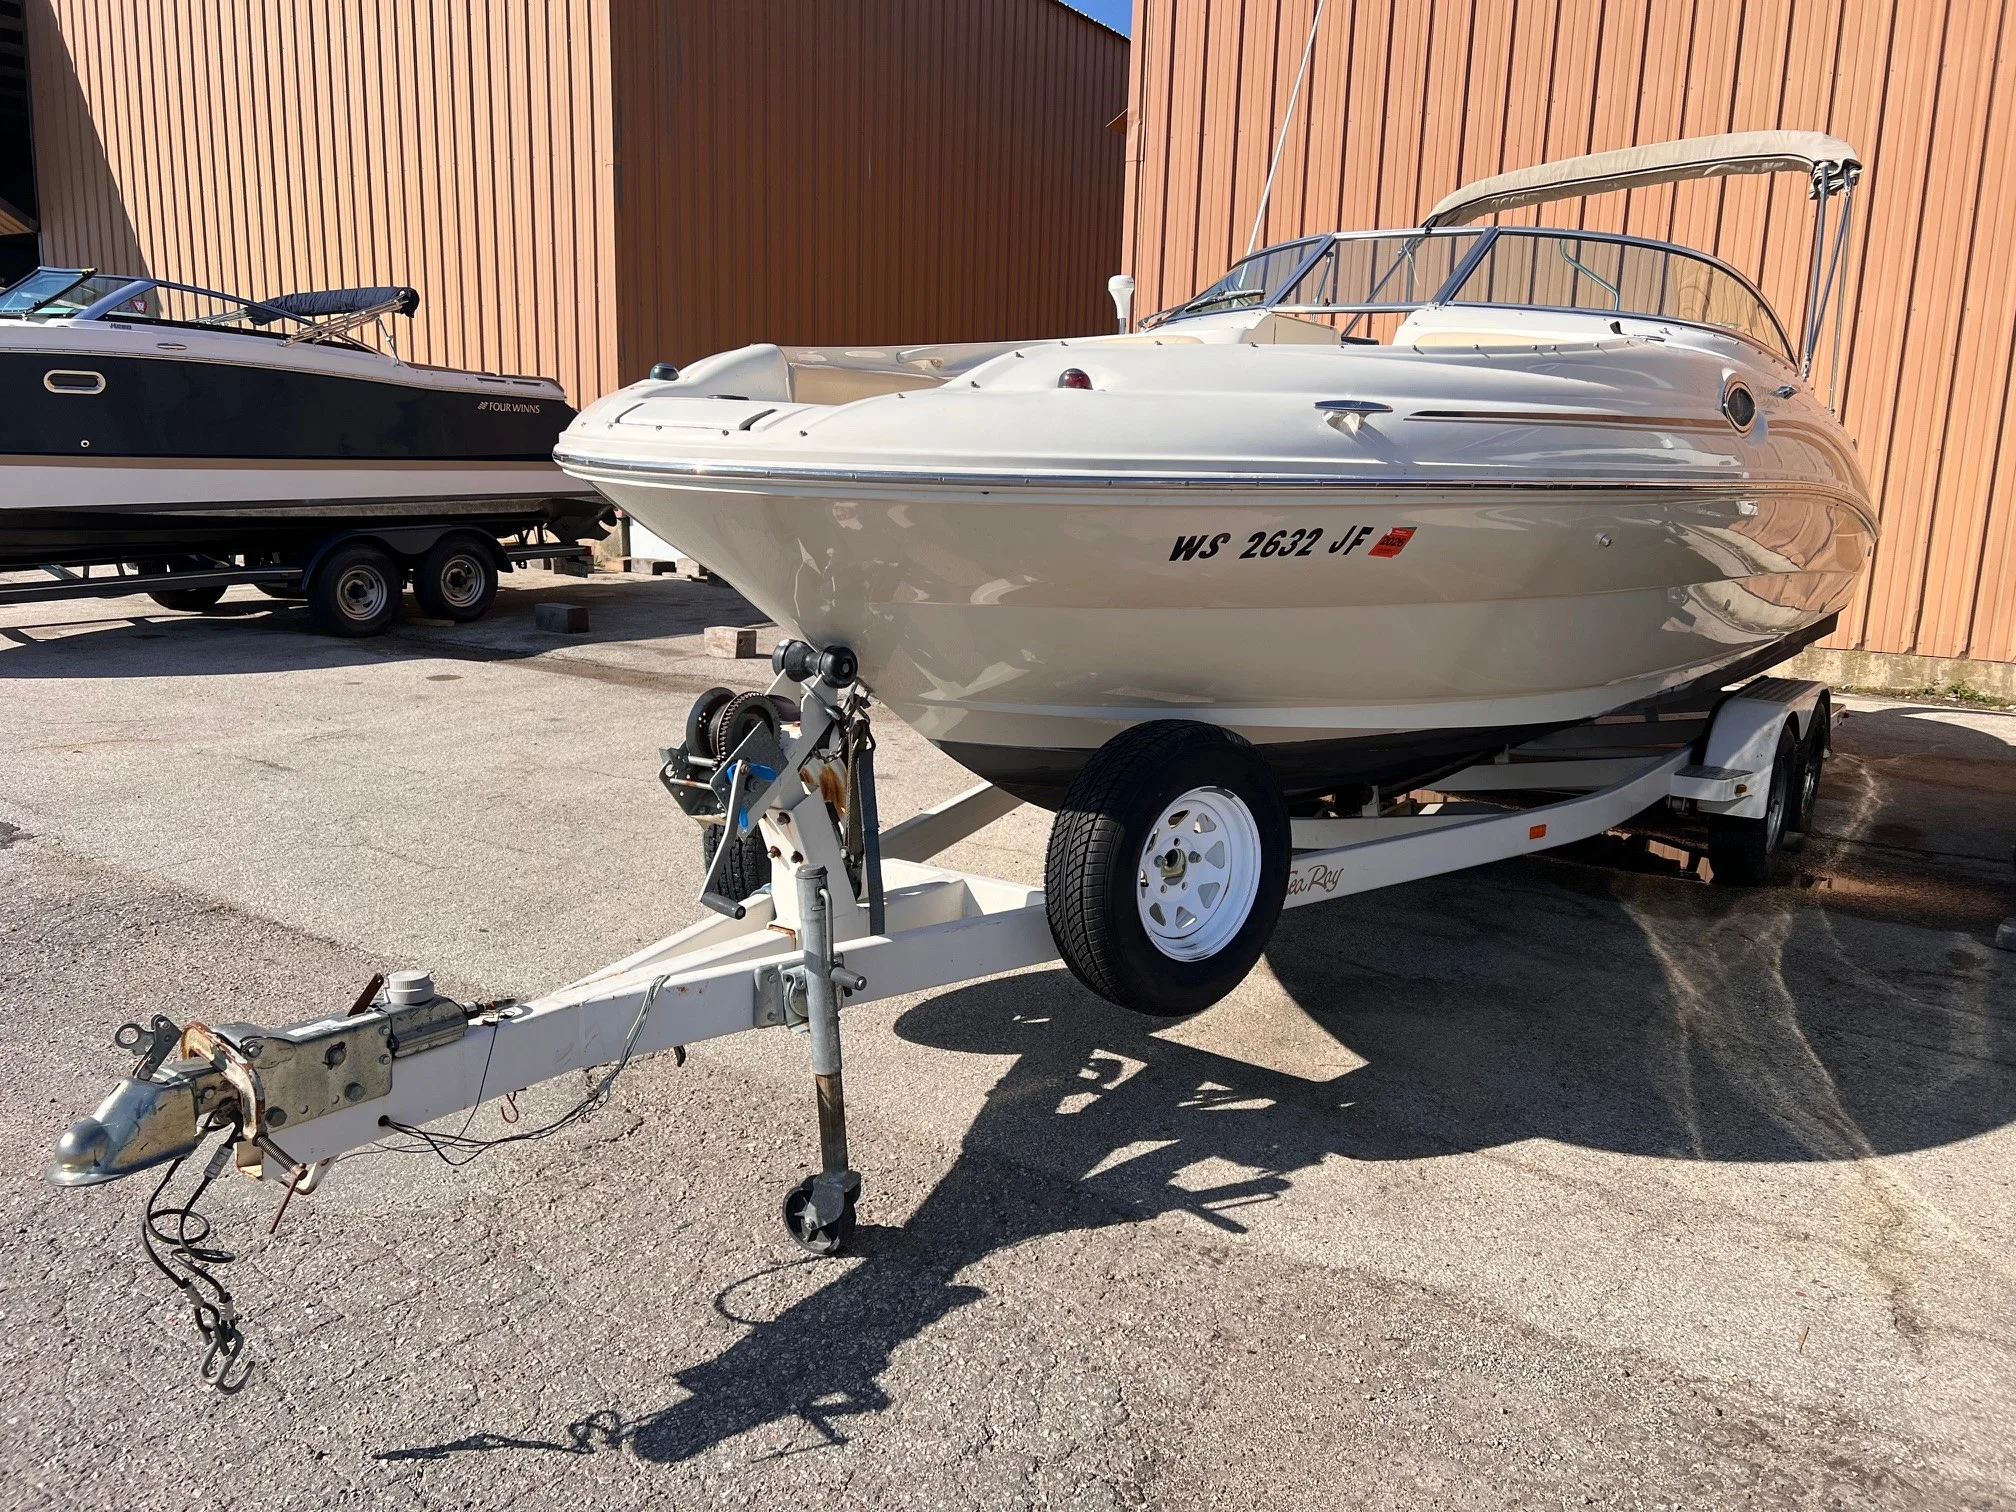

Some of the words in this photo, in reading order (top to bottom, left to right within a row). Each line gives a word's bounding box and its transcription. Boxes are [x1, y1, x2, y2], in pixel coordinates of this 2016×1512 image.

[489, 402, 511, 412] FOUR
[511, 404, 540, 414] WINNS
[1168, 532, 1231, 562] WS
[1238, 527, 1324, 560] 2632
[1328, 525, 1375, 556] JF
[1379, 535, 1404, 547] 2026
[1307, 864, 1344, 892] Ray
